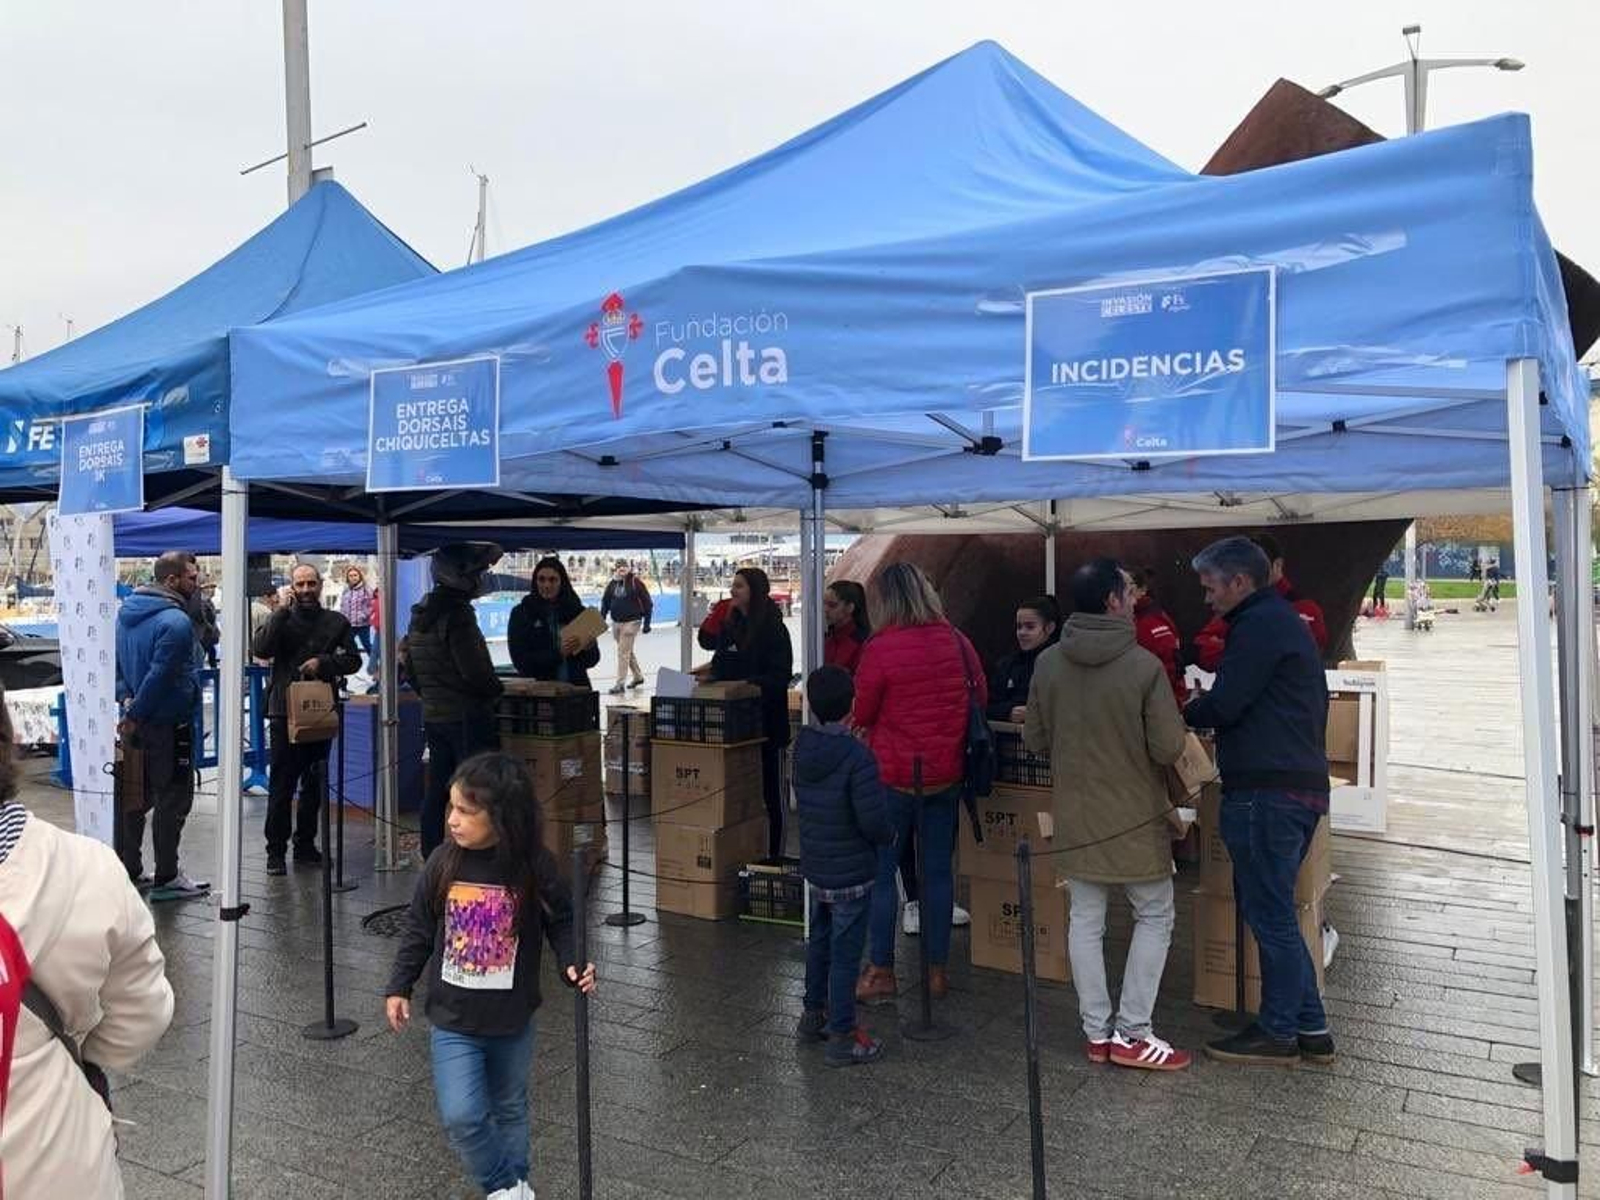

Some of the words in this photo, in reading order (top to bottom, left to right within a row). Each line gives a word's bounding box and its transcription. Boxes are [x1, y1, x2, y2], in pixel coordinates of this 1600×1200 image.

[655, 308, 788, 347] Fundación
[653, 339, 788, 394] Celta
[1051, 348, 1245, 384] INCIDENCIAS
[396, 398, 469, 419] ENTREGA
[397, 415, 468, 435] DORSAIS
[79, 440, 124, 459] ENTREGA
[376, 429, 490, 452] CHIQUICELTAS
[79, 452, 124, 473] DORSAIS
[675, 766, 700, 780] SPT
[985, 811, 1017, 826] SPT
